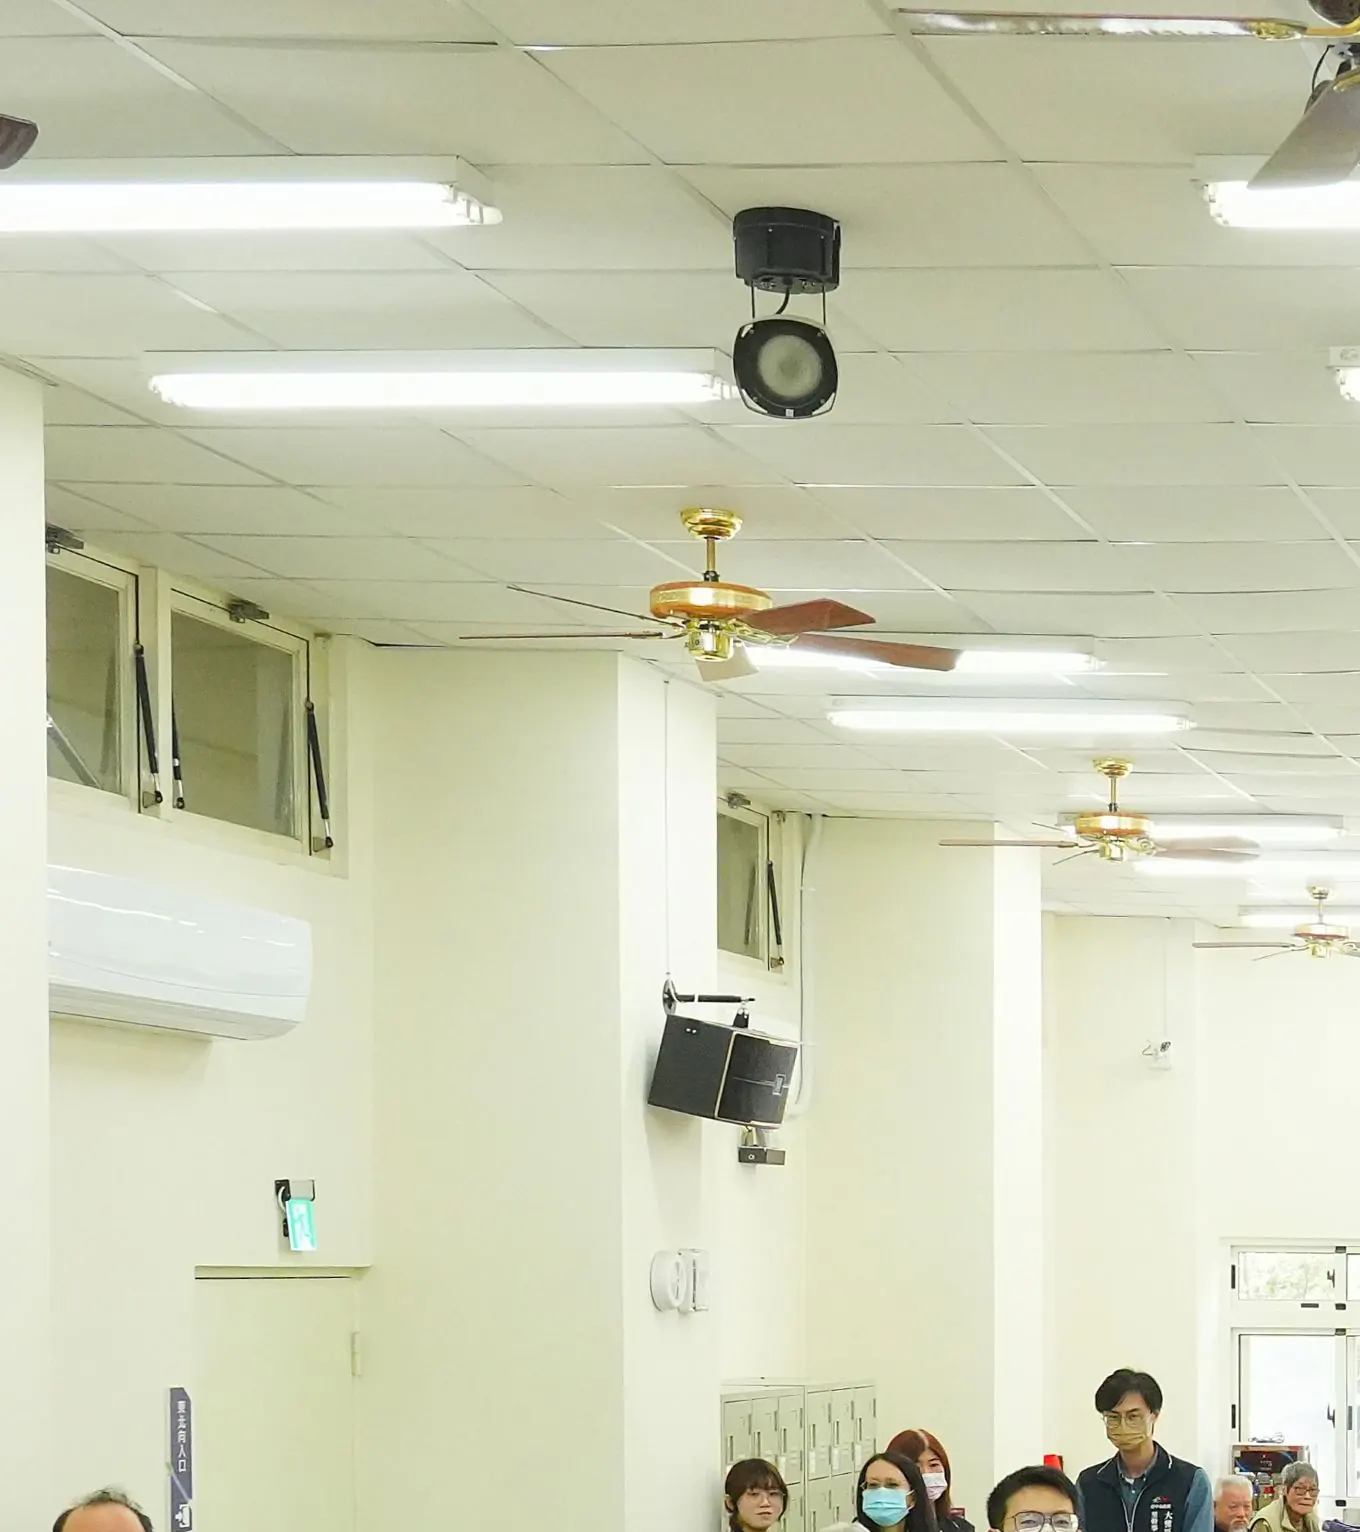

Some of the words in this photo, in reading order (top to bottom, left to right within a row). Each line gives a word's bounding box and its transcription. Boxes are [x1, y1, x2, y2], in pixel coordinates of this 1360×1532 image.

[177, 1400, 187, 1473] 東北向入口
